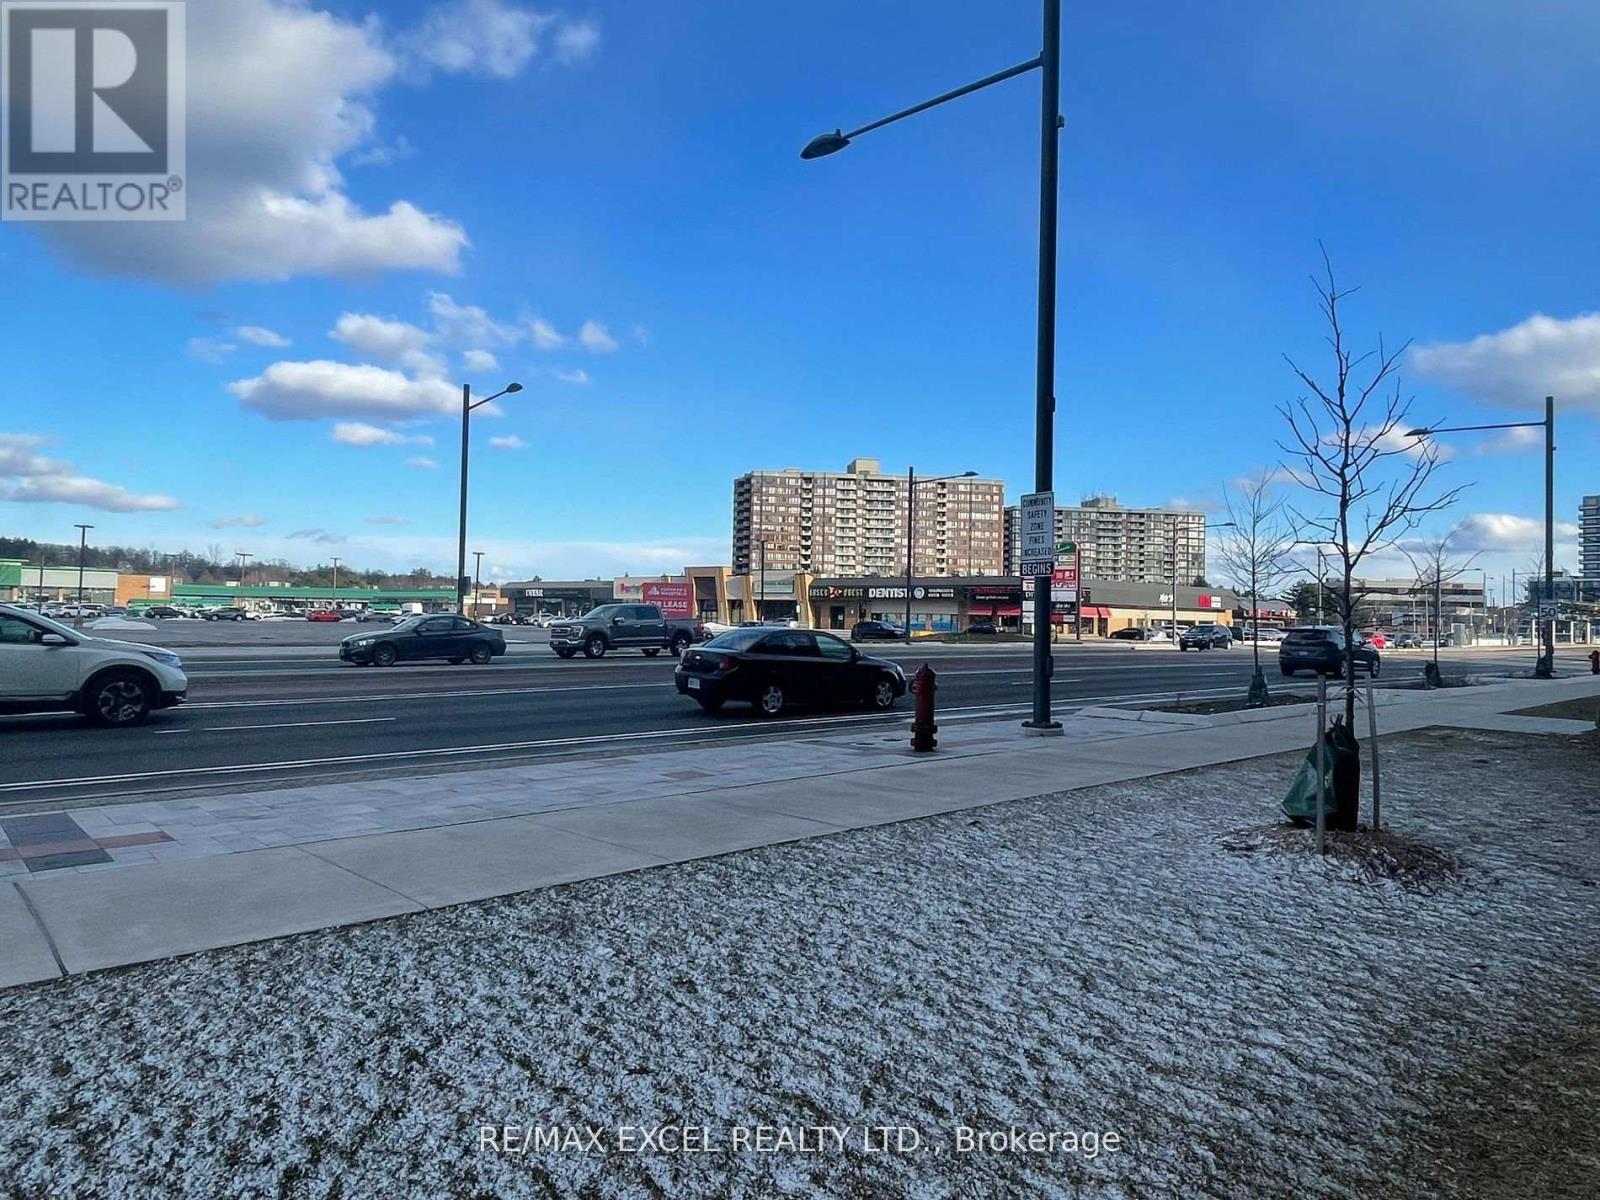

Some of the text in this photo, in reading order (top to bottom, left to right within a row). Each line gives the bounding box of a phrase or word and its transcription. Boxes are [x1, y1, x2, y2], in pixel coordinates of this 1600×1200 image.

[1027, 510, 1047, 519] SAFETY
[1030, 521, 1044, 531] ZONE
[1029, 536, 1045, 544] FINES
[1022, 563, 1051, 575] BEGINS
[1541, 607, 1556, 617] 50
